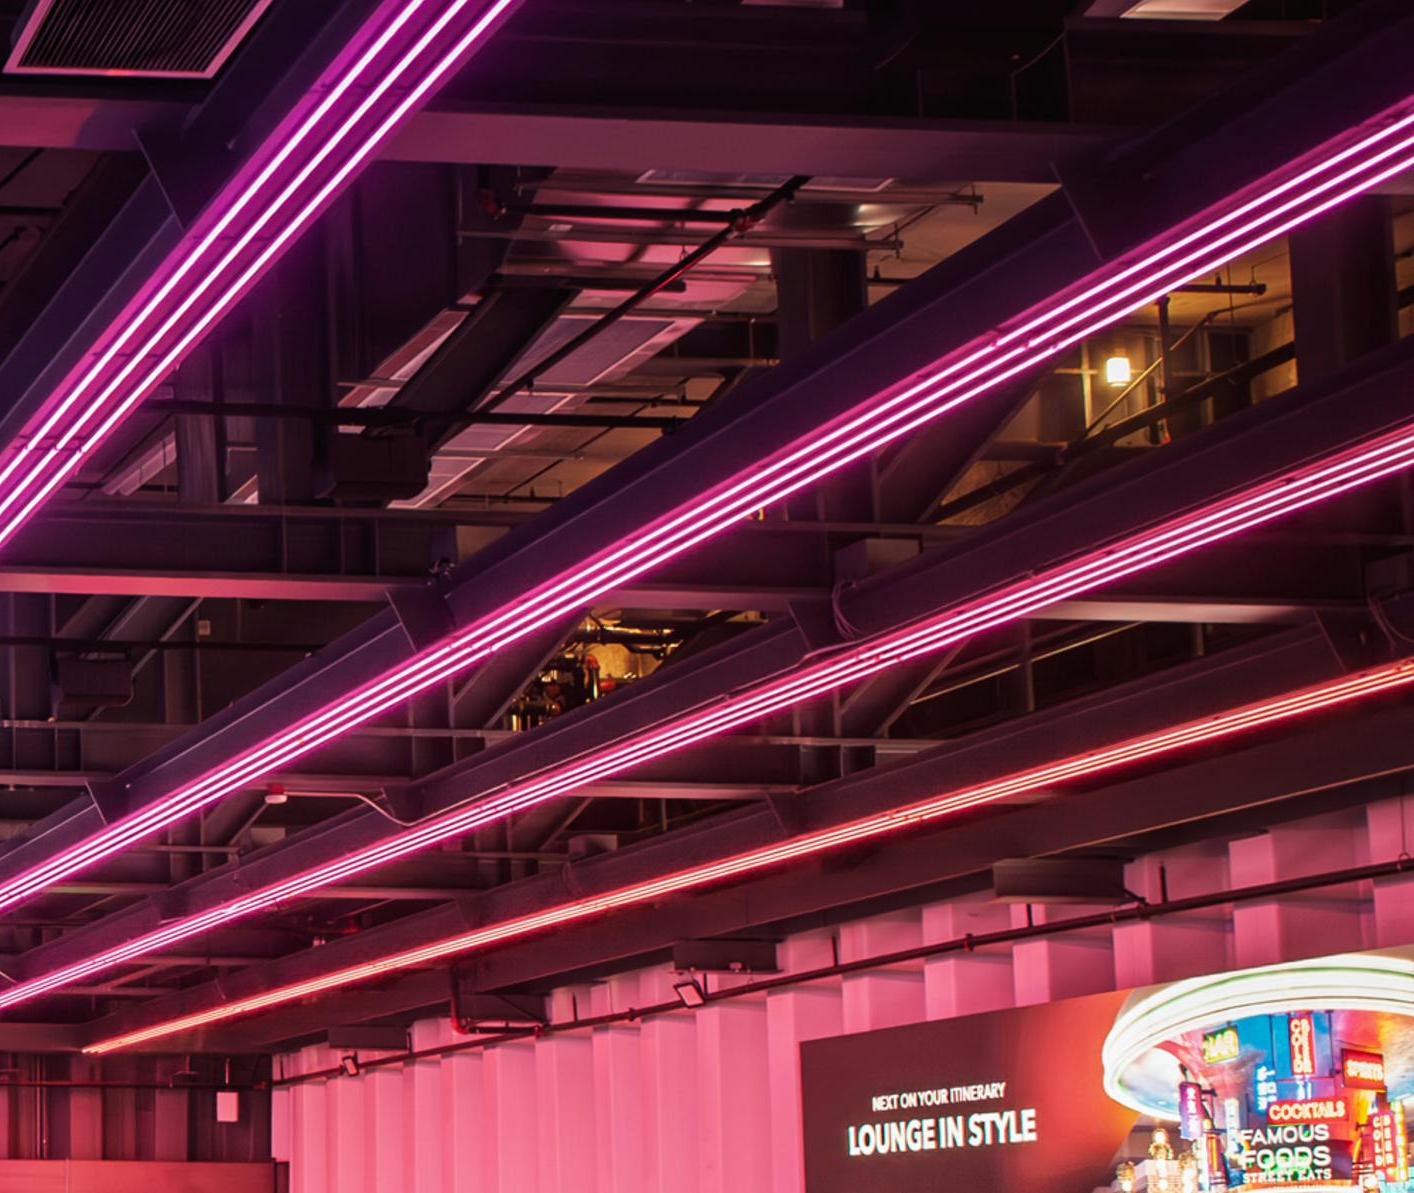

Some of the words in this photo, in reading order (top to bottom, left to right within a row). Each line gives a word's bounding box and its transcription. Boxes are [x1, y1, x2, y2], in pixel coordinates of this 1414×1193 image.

[871, 1094, 899, 1112] NEXT
[899, 1091, 917, 1108] ON
[916, 1088, 948, 1106] YOUR
[949, 1081, 1006, 1103] ITINERARY
[1269, 1101, 1346, 1120] COCKTAILS
[847, 1118, 937, 1156] LOUNGE
[938, 1115, 965, 1149] IN
[968, 1108, 1038, 1147] STYLE
[1241, 1123, 1330, 1146] FAMOUS
[1238, 1145, 1332, 1170] FOODS
[1298, 1167, 1332, 1182] EATS
